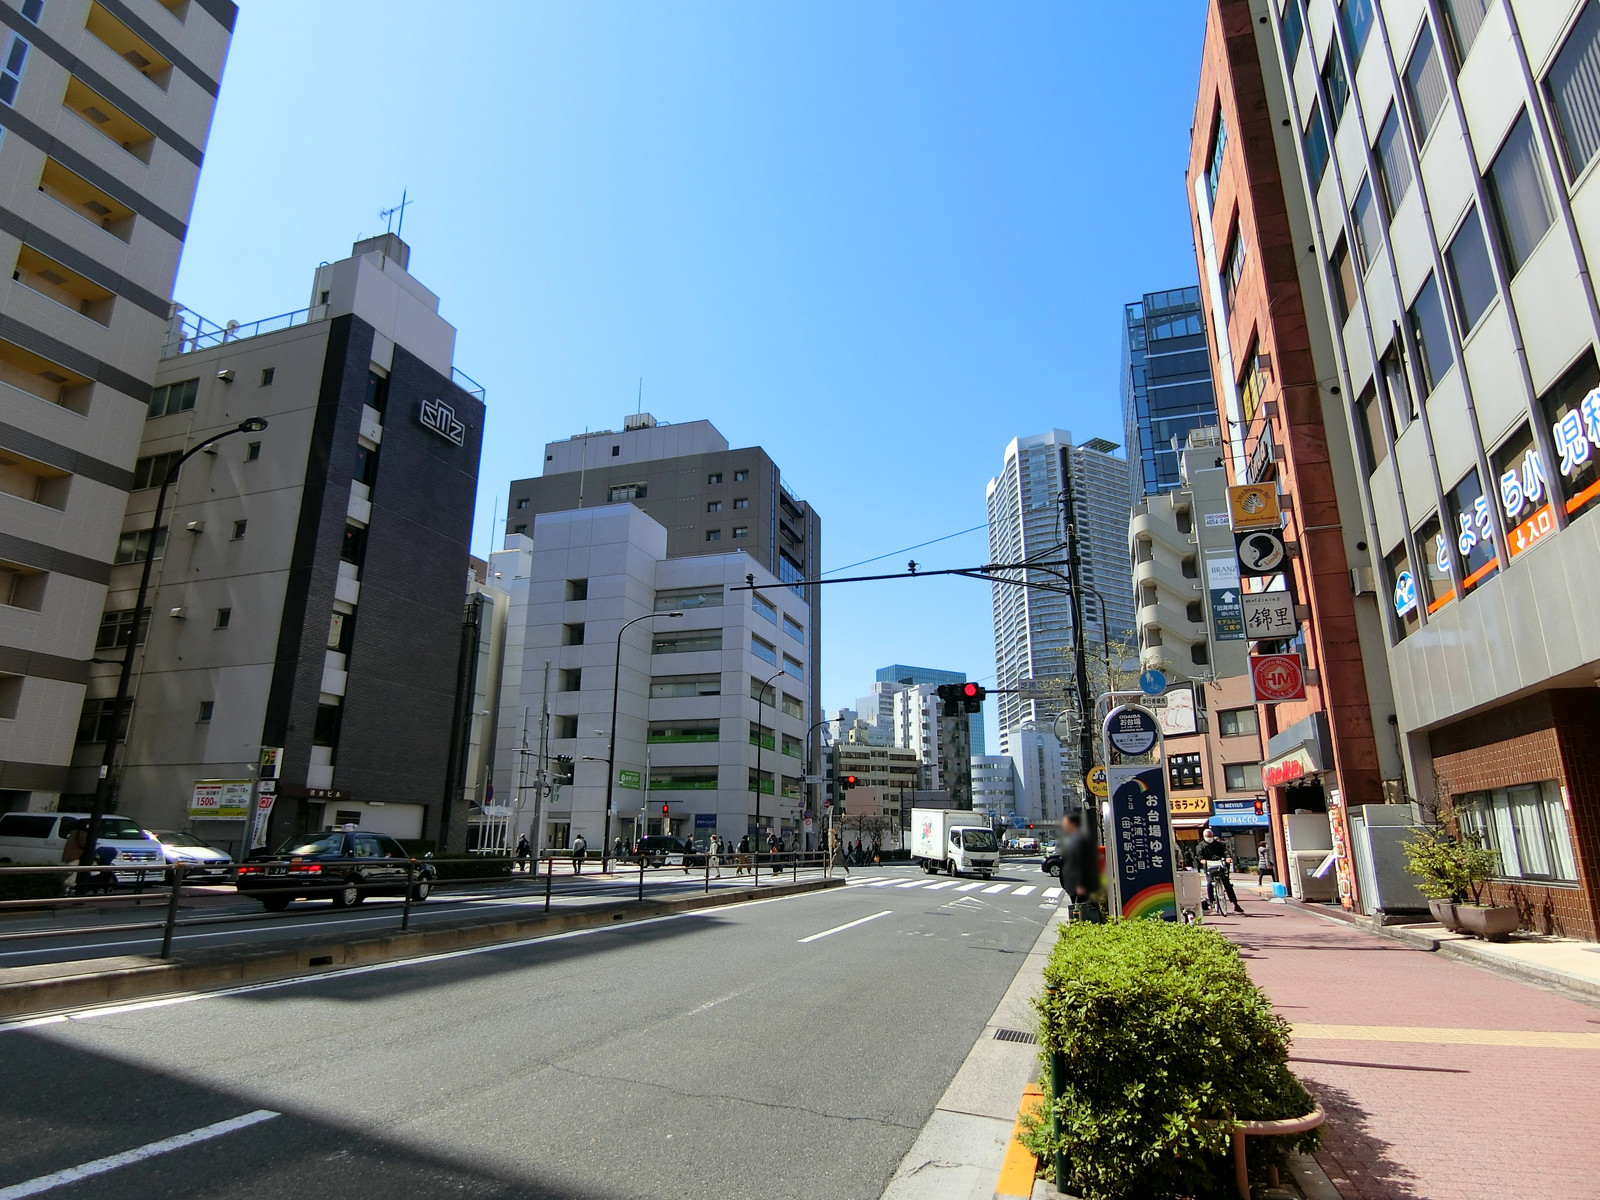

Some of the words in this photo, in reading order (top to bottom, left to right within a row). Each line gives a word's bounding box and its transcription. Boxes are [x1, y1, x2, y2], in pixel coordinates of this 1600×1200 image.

[1527, 511, 1551, 542] 入口
[1249, 606, 1292, 631] 錦里
[1261, 671, 1296, 687] HM
[1120, 718, 1141, 726] お台場
[1145, 794, 1164, 868] お台場ゆき
[1221, 816, 1258, 824] TOBACCO
[1133, 816, 1146, 870] 芝浦三丁目
